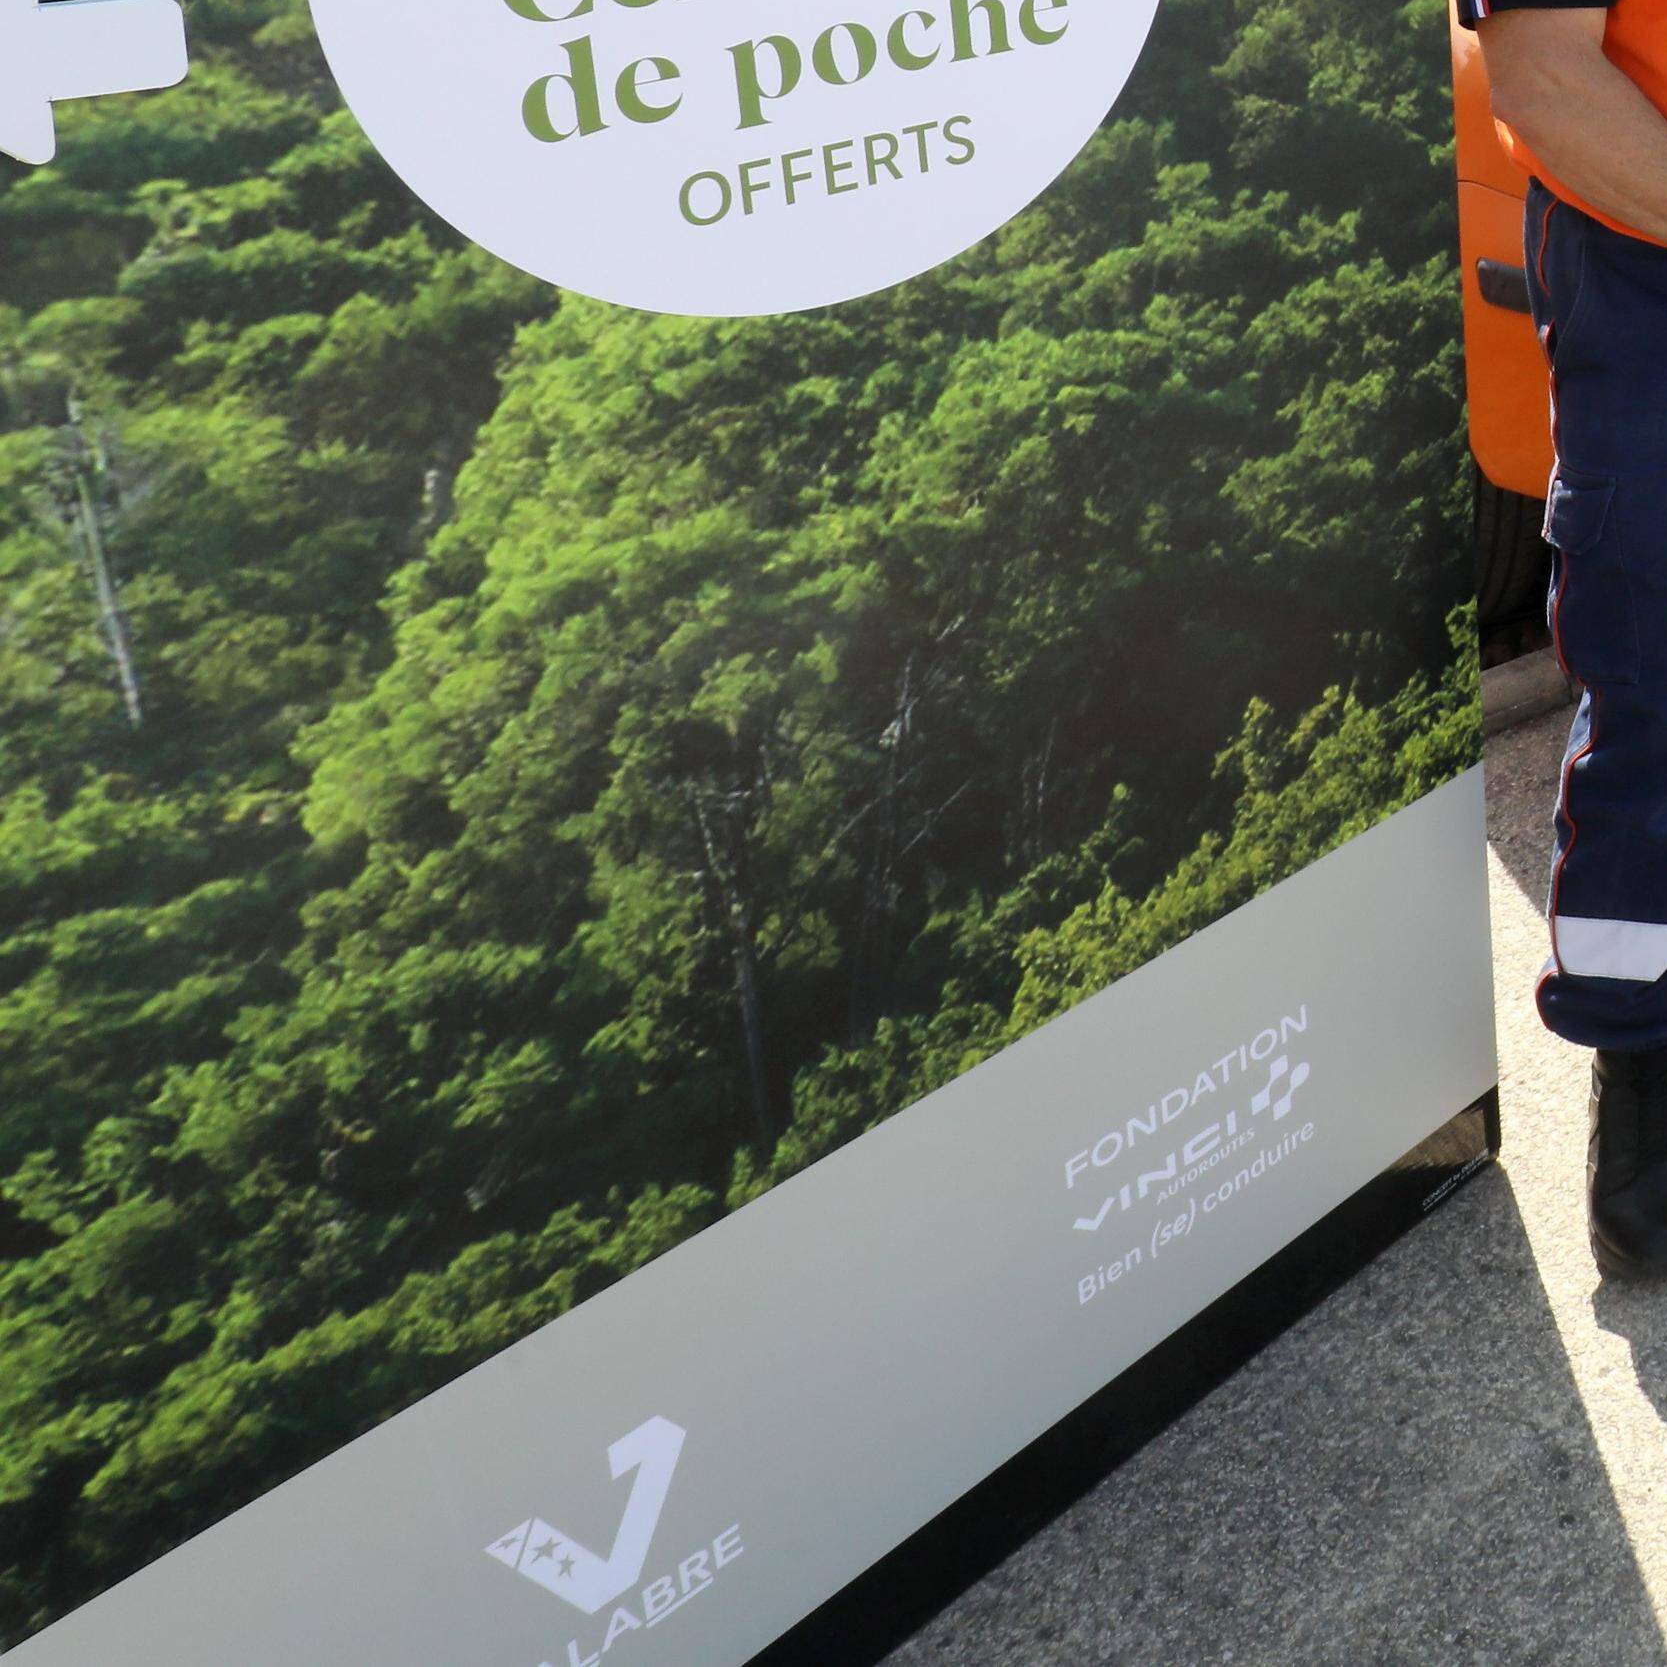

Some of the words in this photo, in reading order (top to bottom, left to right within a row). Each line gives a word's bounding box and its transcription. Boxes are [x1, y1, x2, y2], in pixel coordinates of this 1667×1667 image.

[520, 37, 684, 144] de
[678, 114, 976, 229] OFFERTS
[1063, 1003, 1309, 1189] FONDATION
[1072, 1110, 1238, 1232] VINCI
[1077, 1246, 1143, 1306] Bien
[1151, 1198, 1197, 1258] (se)
[1203, 1120, 1314, 1213] conduire
[1156, 1127, 1256, 1206] AUTOROUTES
